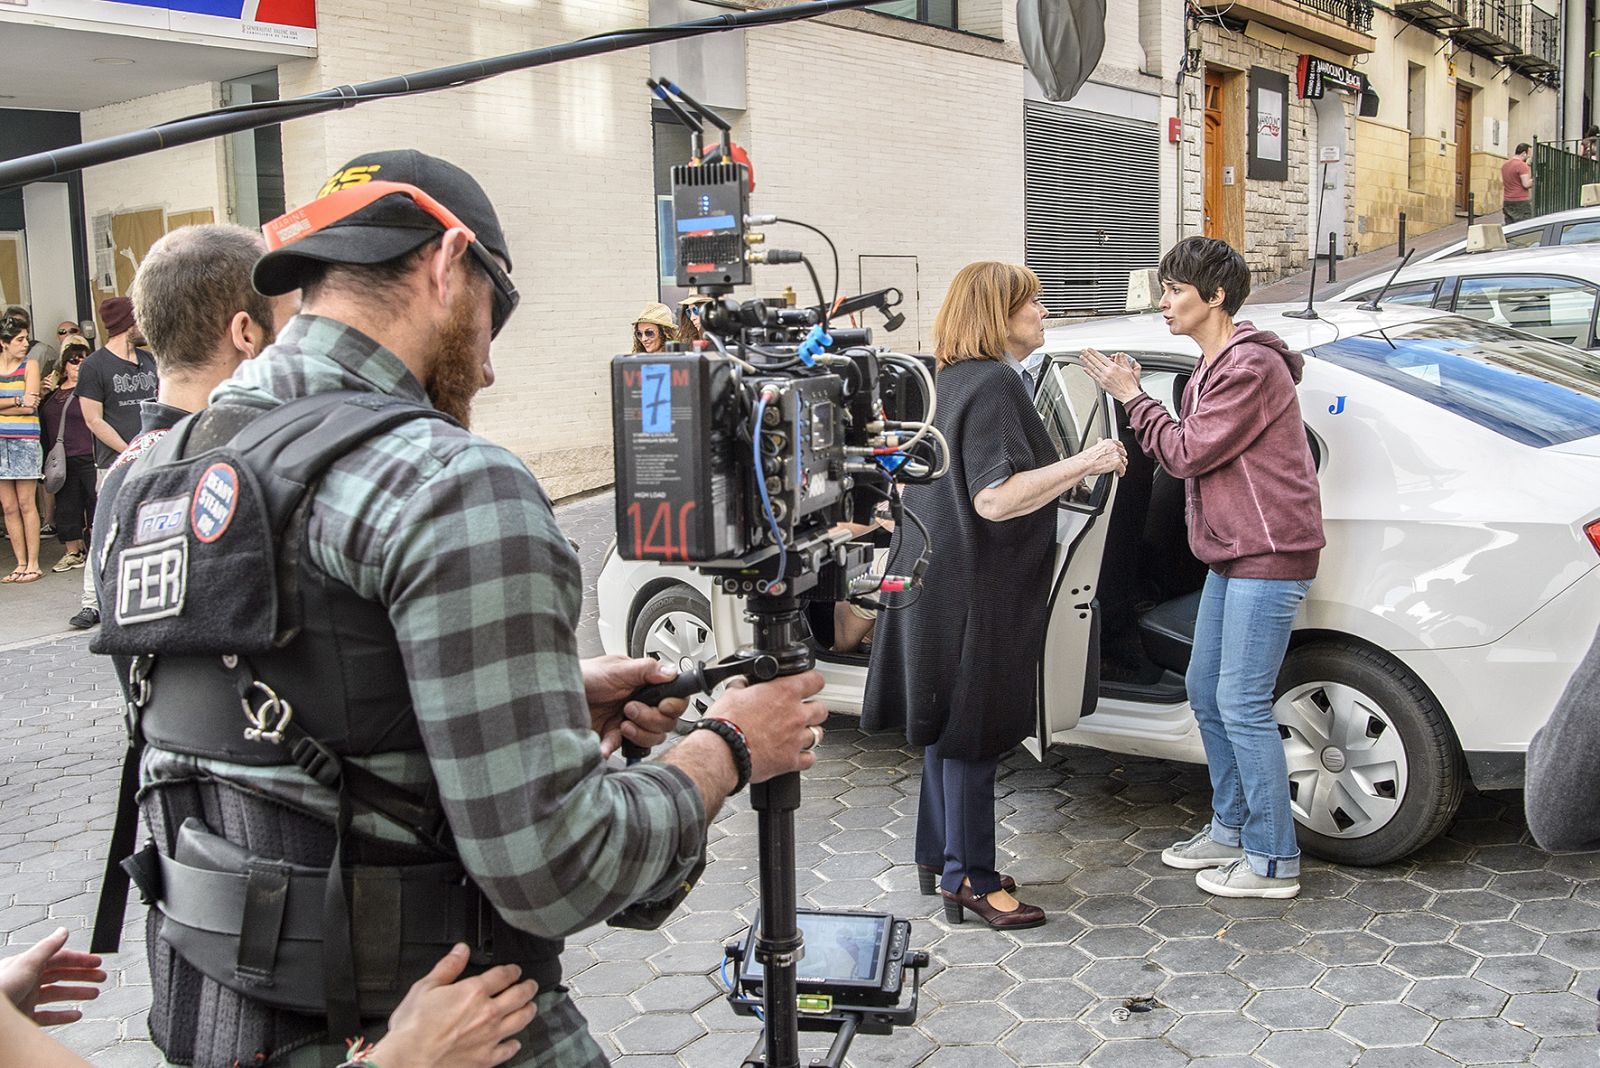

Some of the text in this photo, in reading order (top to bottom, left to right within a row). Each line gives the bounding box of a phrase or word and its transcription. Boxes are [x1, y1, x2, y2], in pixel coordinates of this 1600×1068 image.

[646, 372, 671, 426] 7
[1328, 395, 1347, 415] J
[121, 549, 183, 614] FER
